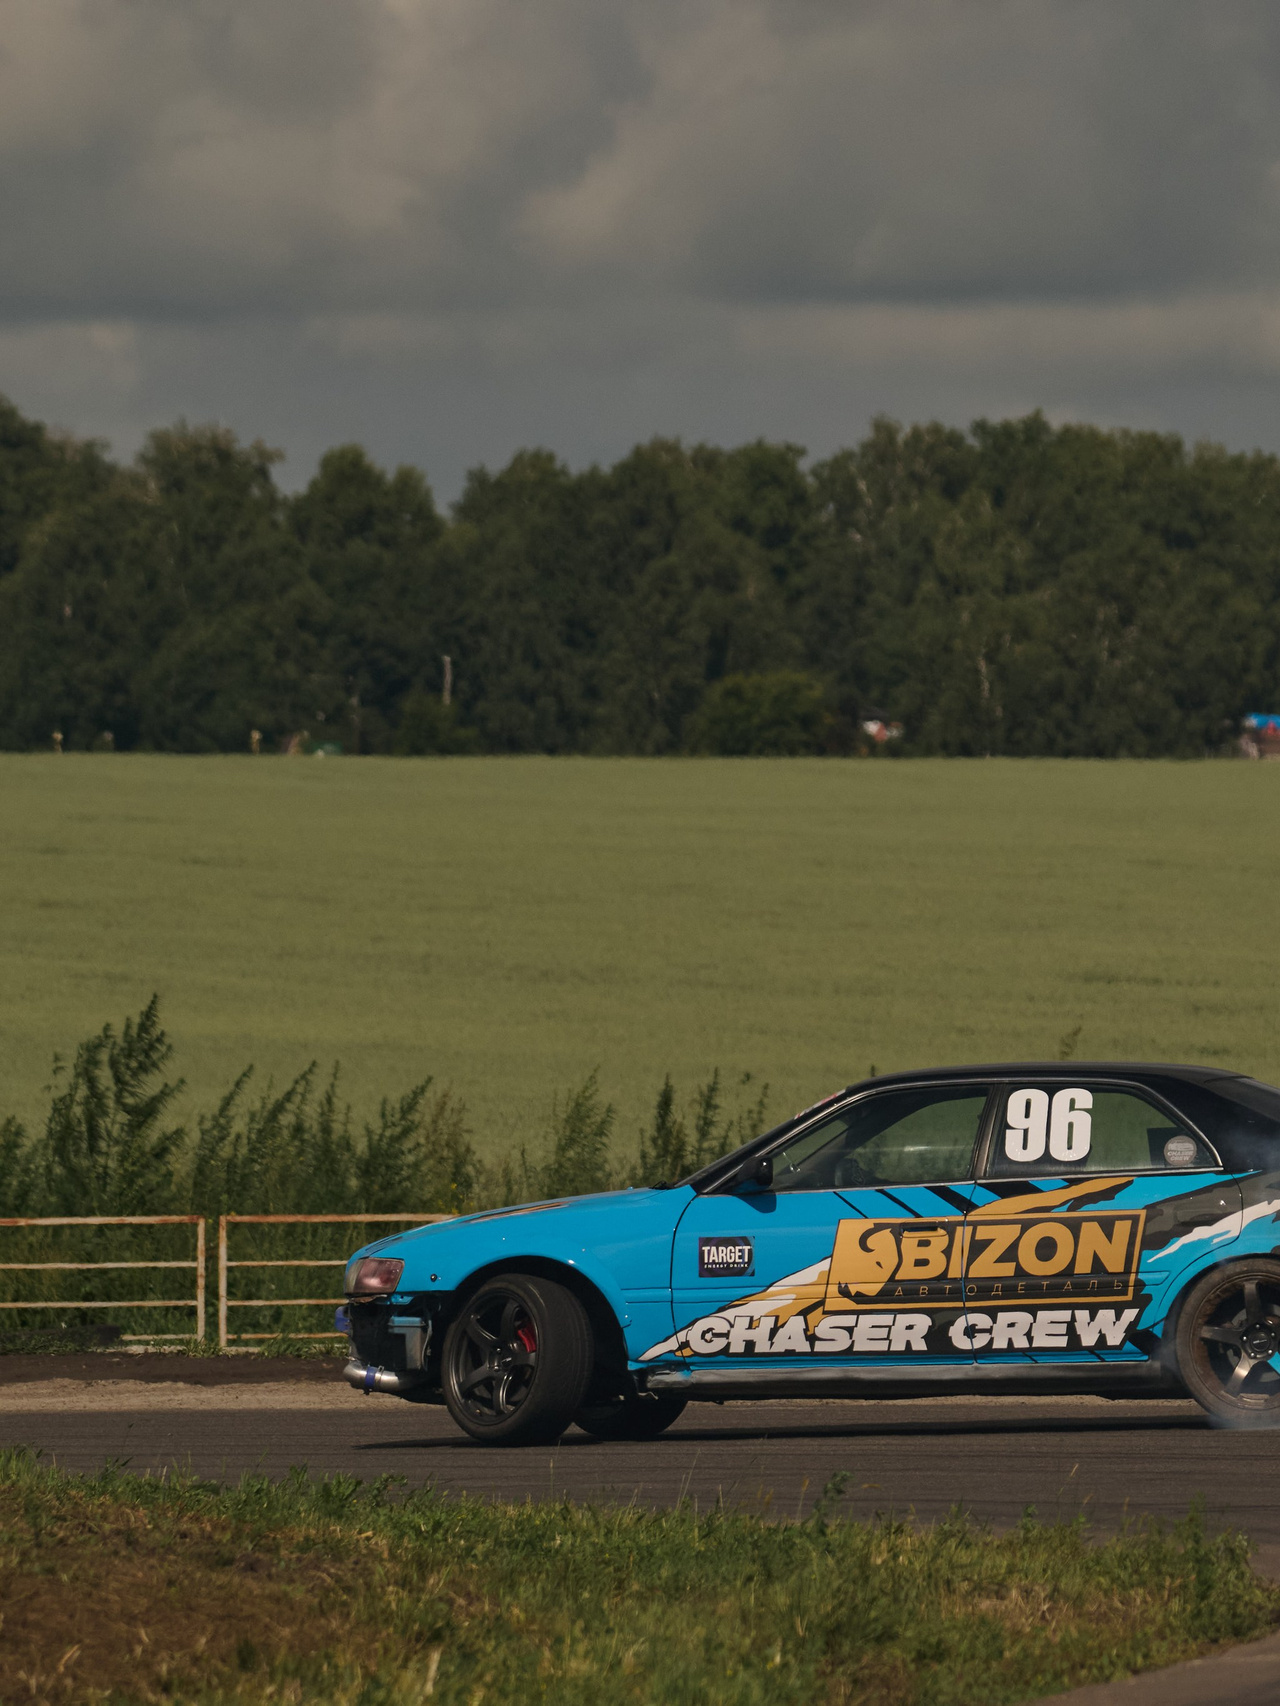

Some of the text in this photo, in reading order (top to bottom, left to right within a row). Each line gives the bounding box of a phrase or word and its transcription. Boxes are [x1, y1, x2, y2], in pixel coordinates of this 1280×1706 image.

[1005, 1088, 1093, 1162] 96
[702, 1245, 751, 1263] TARGET
[895, 1219, 1134, 1281] BIZON
[895, 1280, 1124, 1298] АВТОДЕТАЛЬ
[688, 1308, 1140, 1355] CHASER CREW
